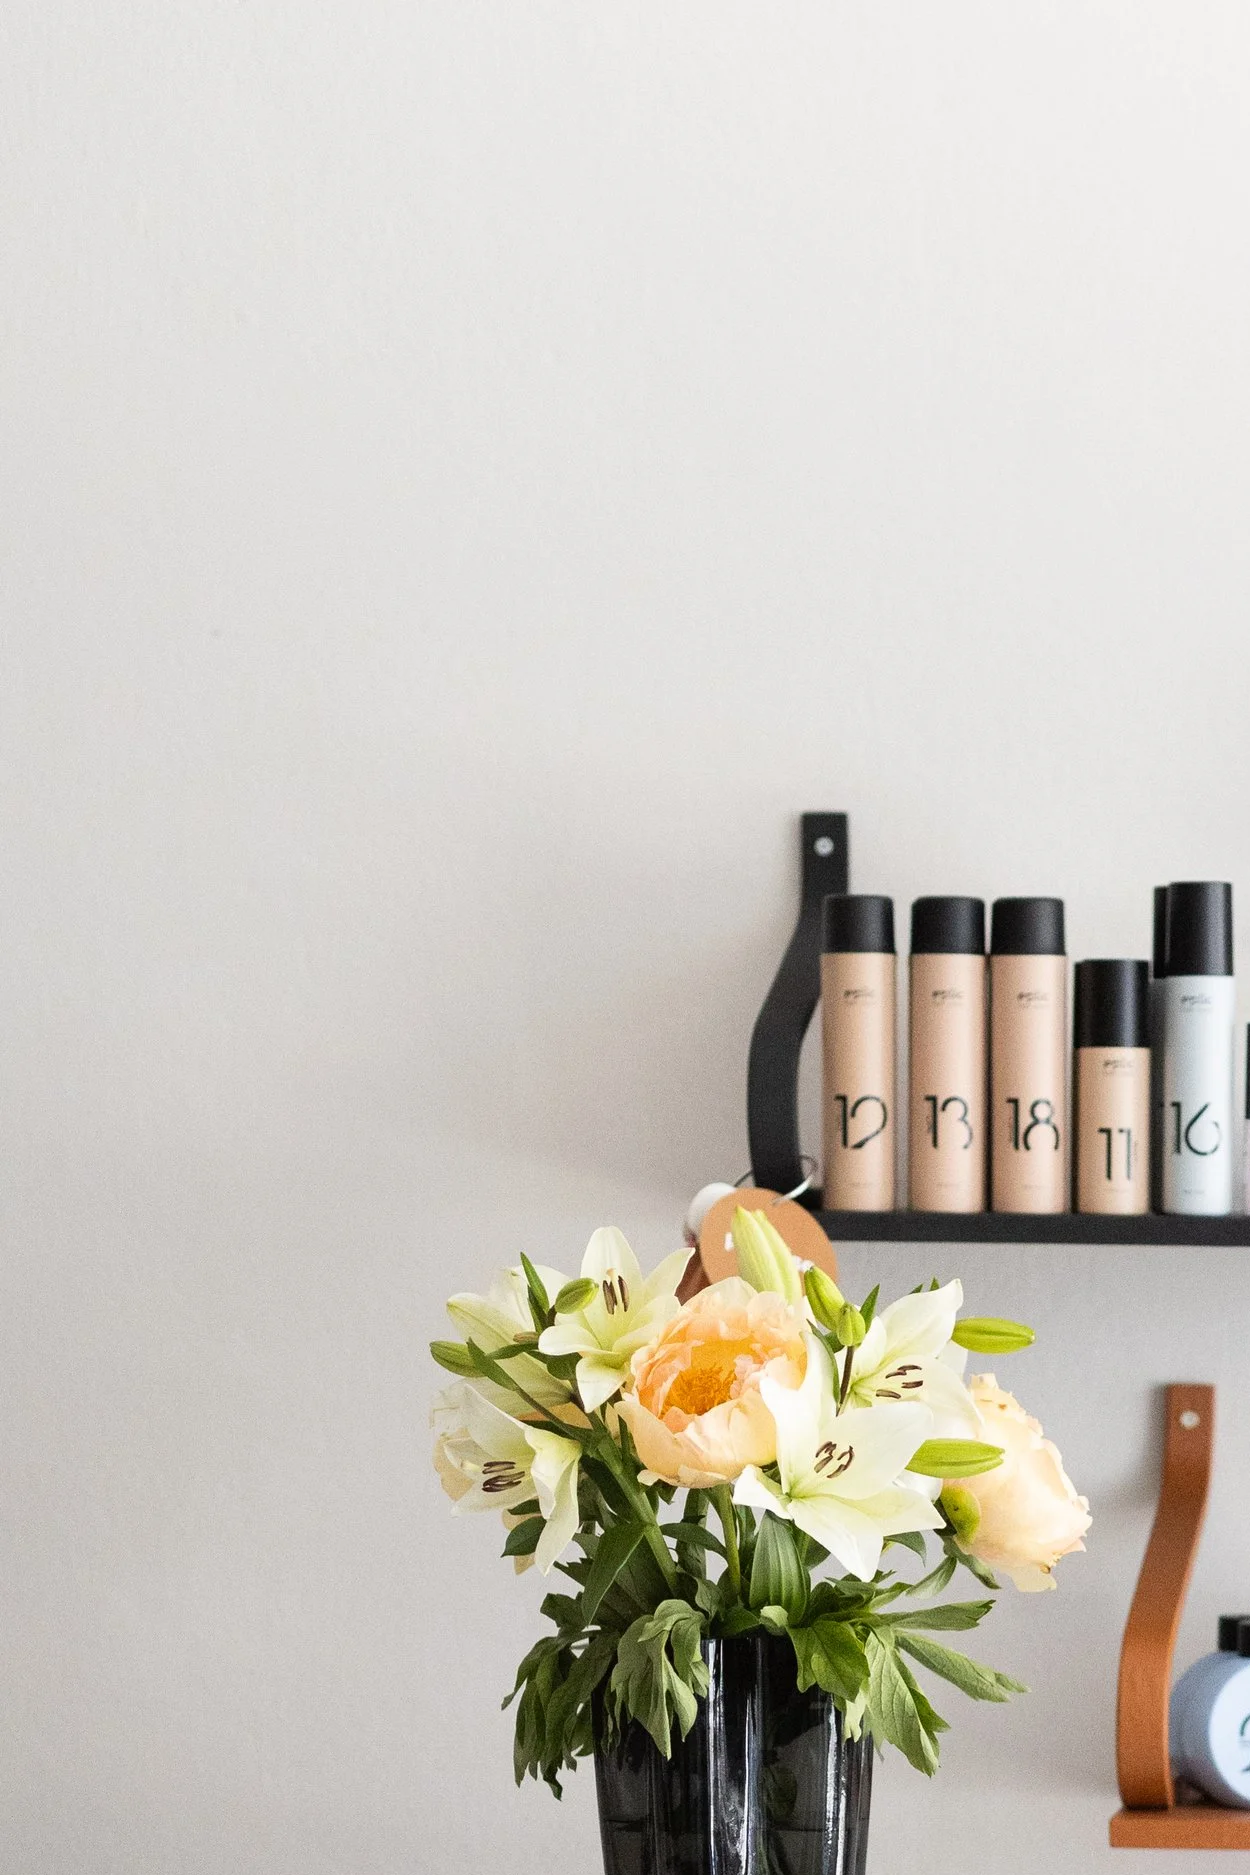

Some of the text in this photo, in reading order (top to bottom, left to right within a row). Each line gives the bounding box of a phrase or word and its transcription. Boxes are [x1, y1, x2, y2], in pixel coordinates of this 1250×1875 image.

[834, 1094, 888, 1150] 12
[924, 1094, 974, 1151] 13
[1006, 1096, 1060, 1152] 18
[1170, 1101, 1223, 1157] 16
[1096, 1127, 1134, 1182] 11
